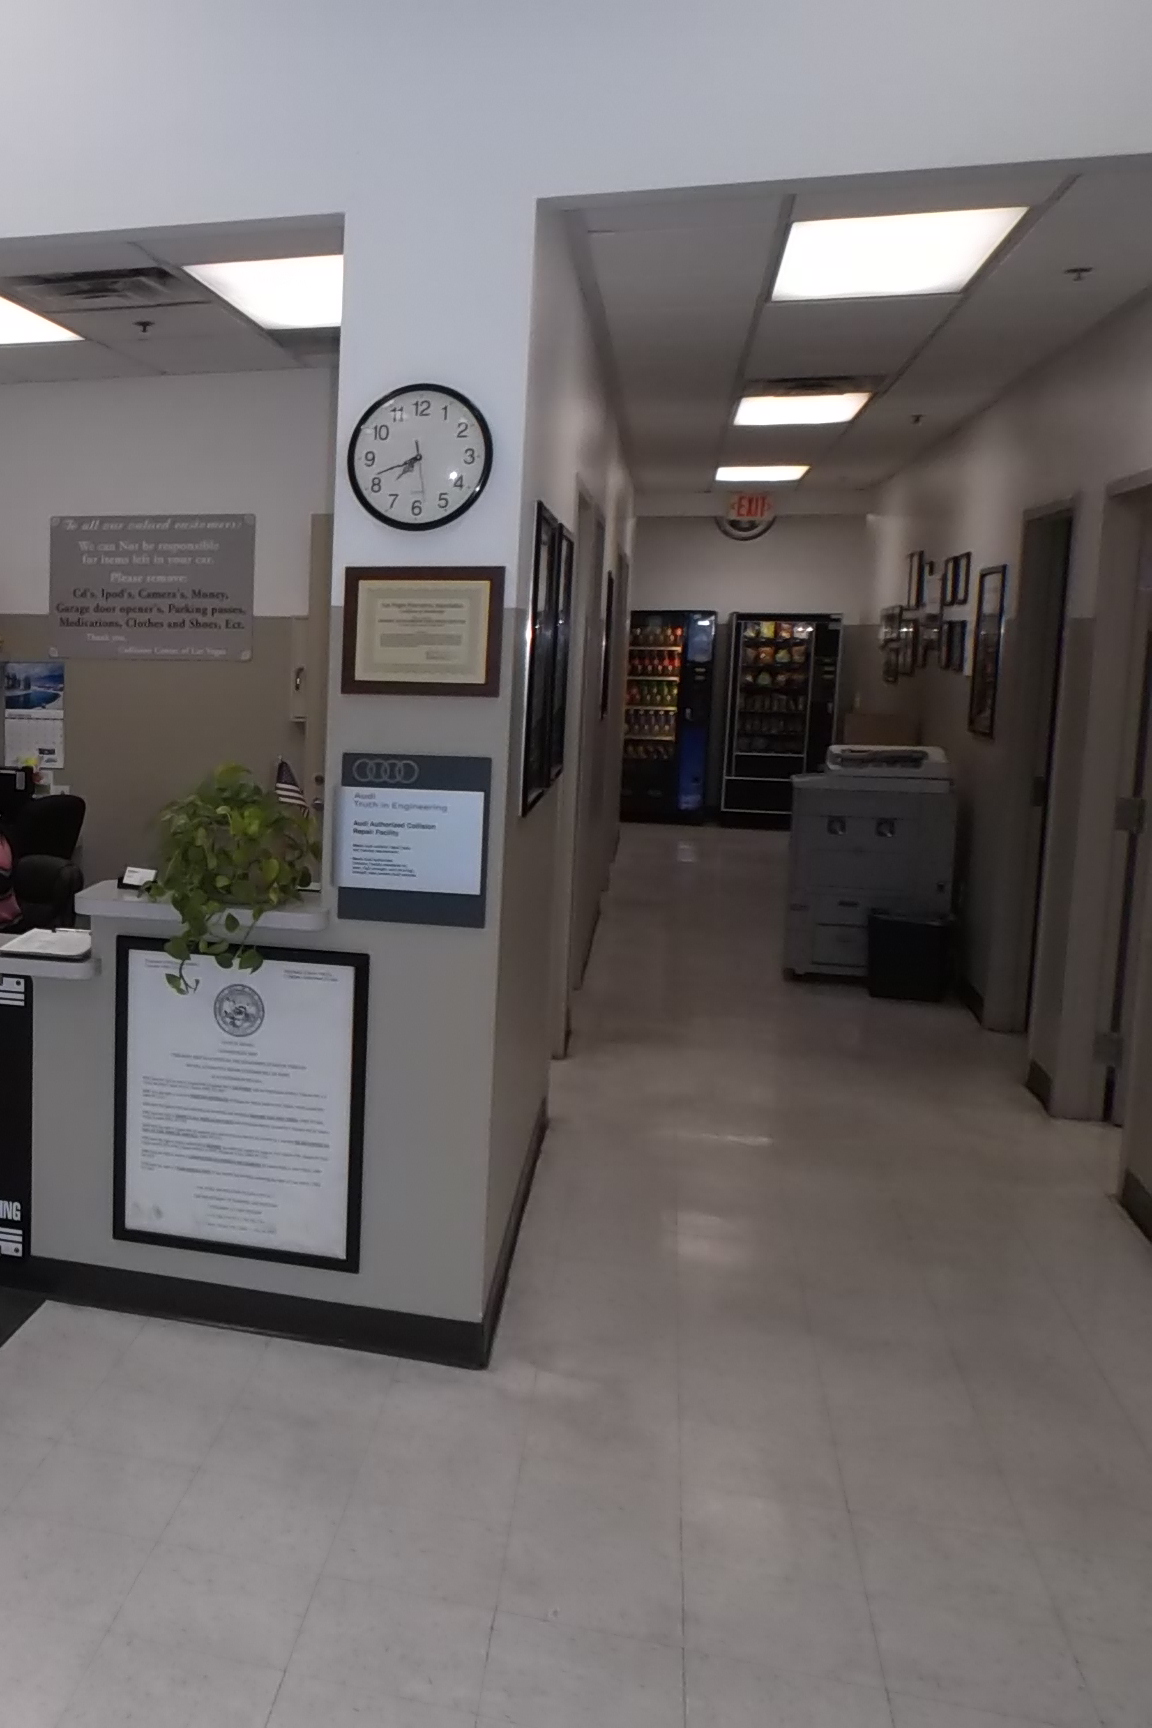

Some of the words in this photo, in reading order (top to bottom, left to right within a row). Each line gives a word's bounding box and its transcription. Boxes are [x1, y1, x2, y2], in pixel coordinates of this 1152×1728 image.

[390, 406, 405, 423] 11
[412, 400, 431, 417] 12
[441, 405, 449, 421] 1
[373, 424, 390, 441] 10
[456, 422, 469, 438] 2
[364, 450, 376, 467] 9
[463, 448, 476, 465] 3
[370, 476, 382, 493] 8
[453, 474, 464, 491] 4
[388, 493, 400, 509] 7
[410, 499, 423, 516] 6
[437, 492, 449, 509] 5
[737, 495, 768, 517] EXIT
[109, 571, 145, 584] Please
[54, 602, 91, 617] Garage
[93, 602, 117, 614] door
[167, 603, 209, 618] Parking
[124, 617, 165, 629] Clothes
[166, 618, 186, 630] and
[354, 800, 379, 809] Truth
[391, 802, 448, 814] Engineering
